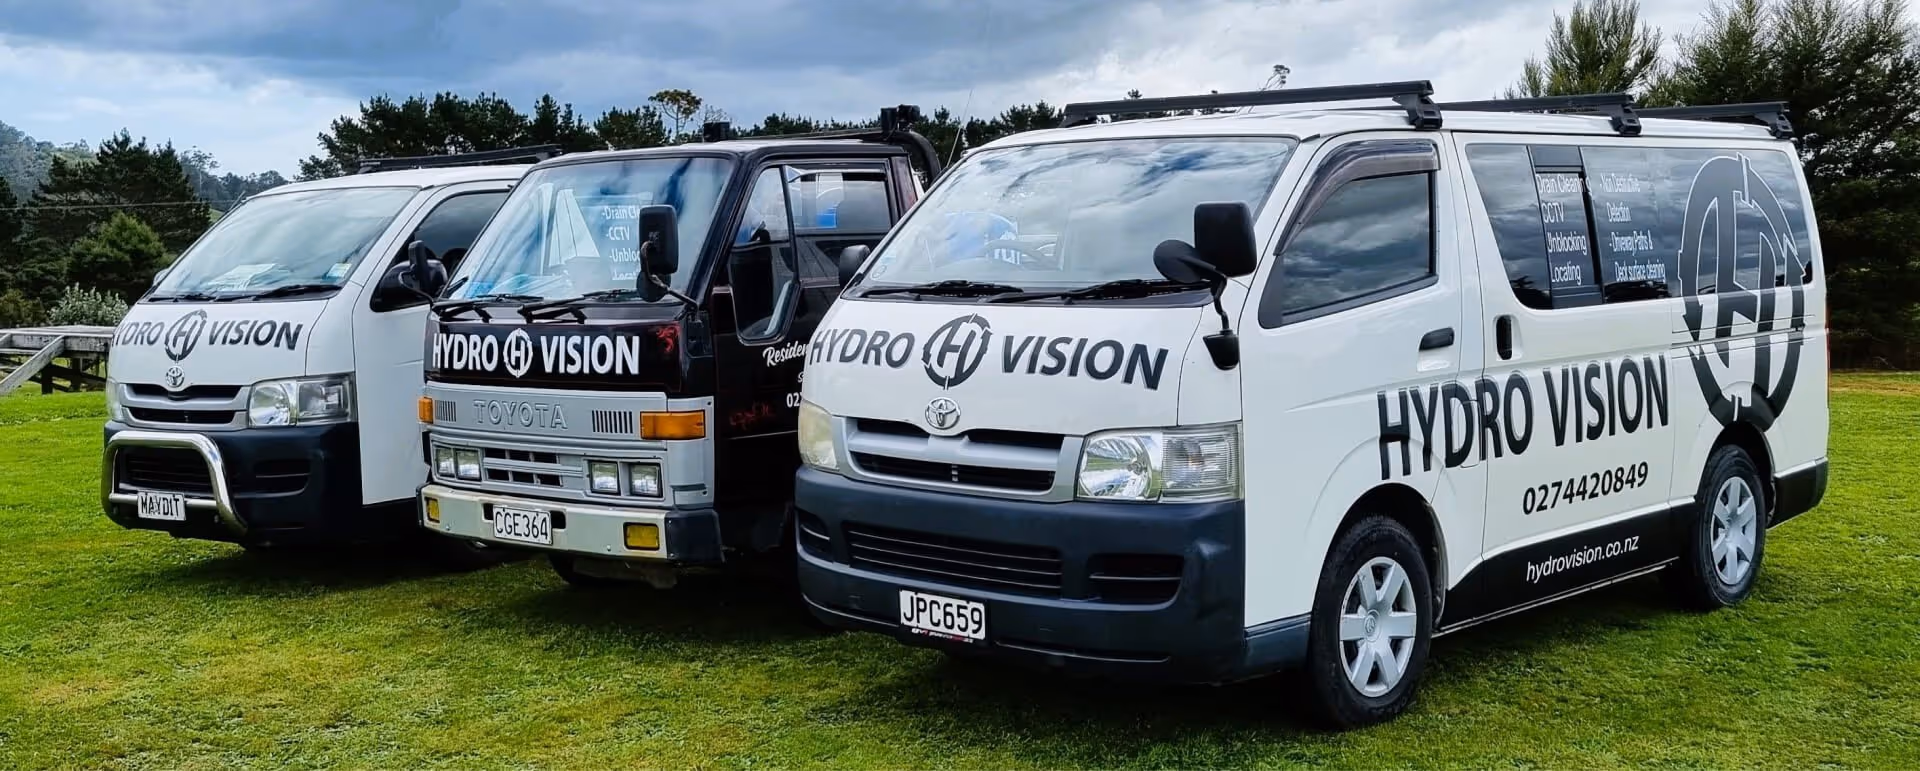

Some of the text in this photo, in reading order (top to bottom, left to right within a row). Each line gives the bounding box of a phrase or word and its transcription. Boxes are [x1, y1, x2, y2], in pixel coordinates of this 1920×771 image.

[1535, 174, 1592, 197] Drain Cleaning
[1541, 202, 1564, 223] CCTV
[1550, 261, 1581, 286] Locating
[1645, 259, 1666, 284] cleaning
[209, 320, 303, 350] VISION
[432, 333, 499, 371] HYDRO
[540, 335, 640, 375] VISION
[809, 328, 915, 369] HYDRO
[1002, 335, 1169, 391] VISION
[473, 400, 568, 430] TOYOTA
[1377, 352, 1670, 481] HYDRO VISION
[1522, 461, 1649, 515] 0274420849
[495, 511, 548, 540] CGE364
[1526, 535, 1640, 583] hydrovision.co.nz
[903, 595, 983, 635] JPC659
